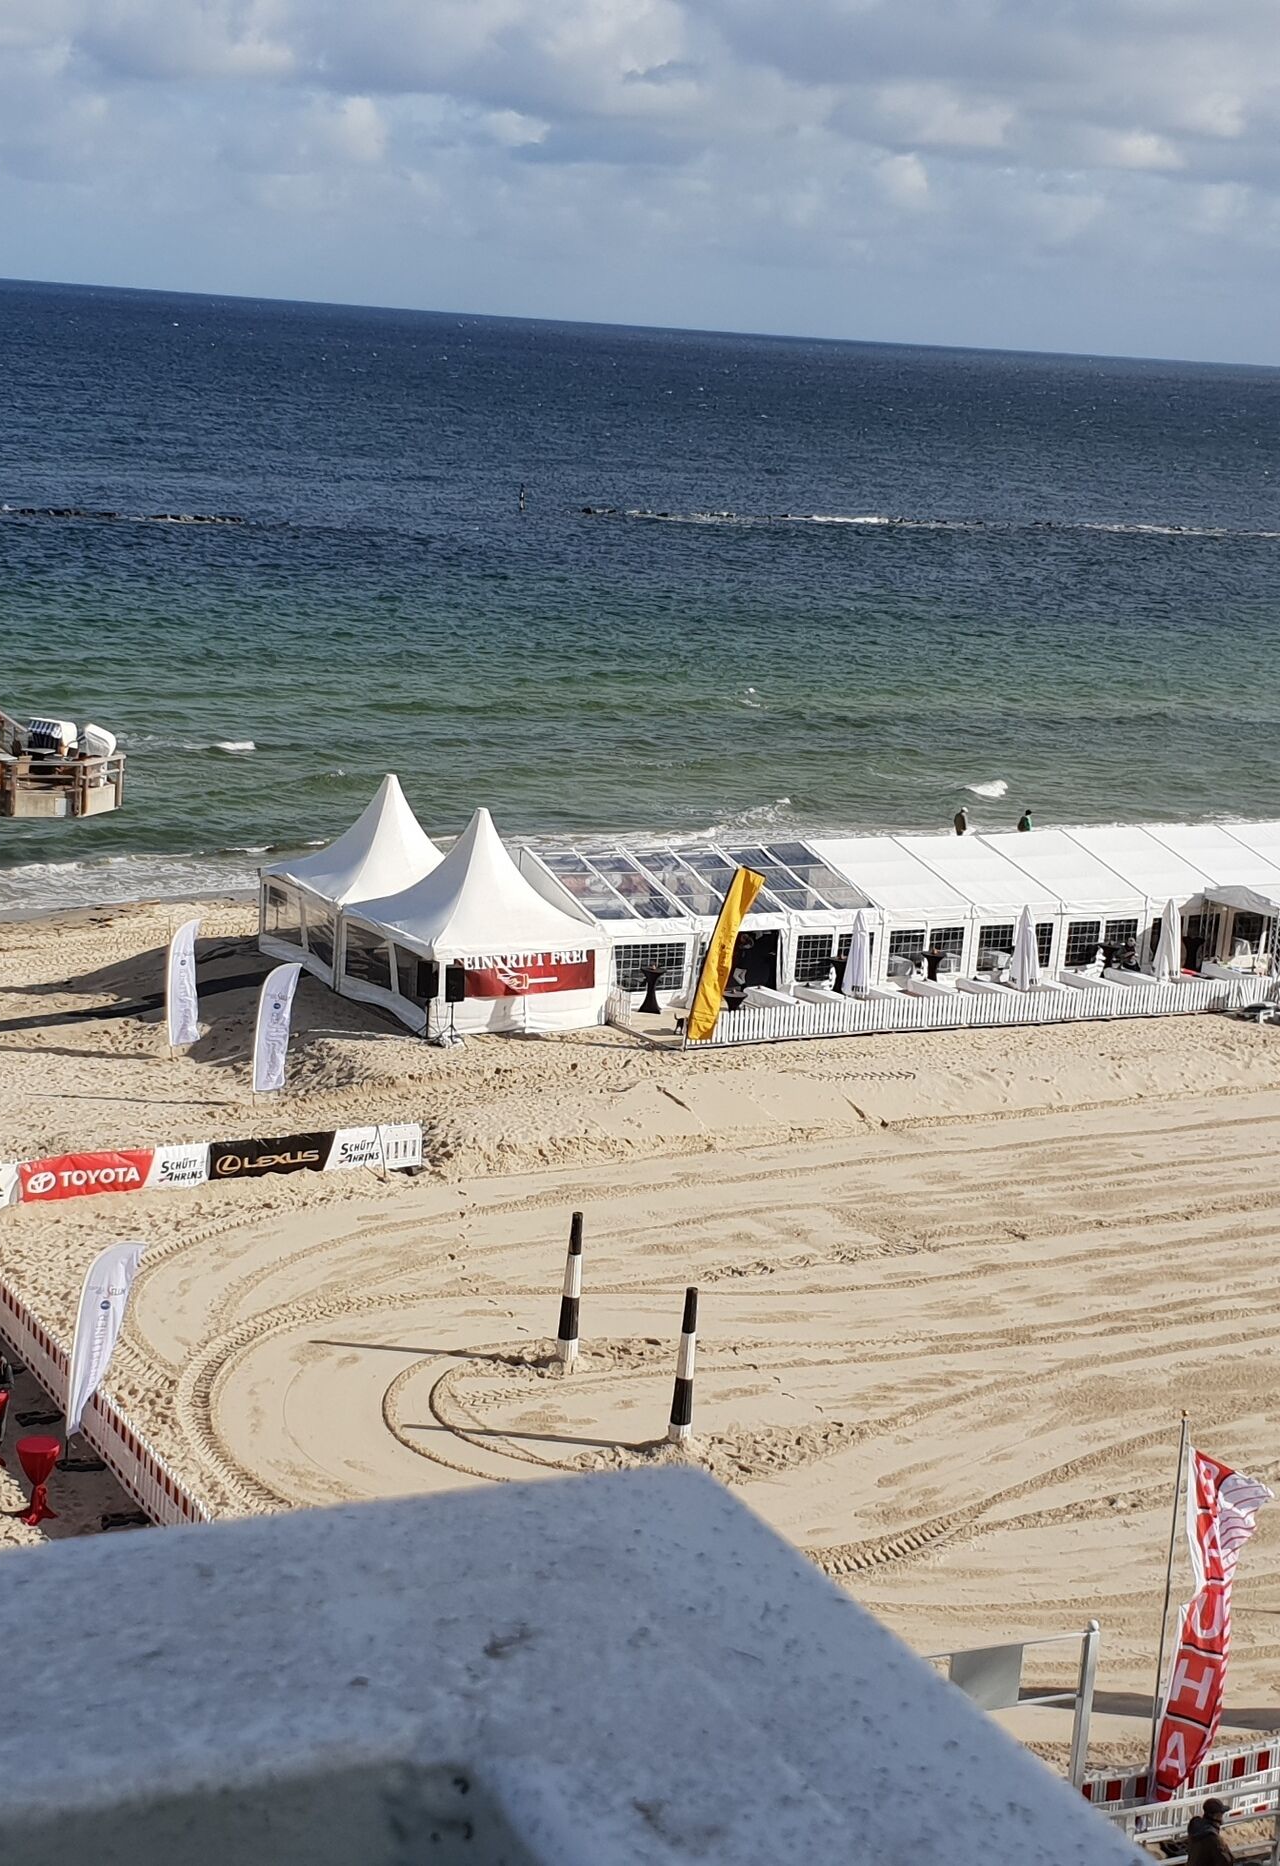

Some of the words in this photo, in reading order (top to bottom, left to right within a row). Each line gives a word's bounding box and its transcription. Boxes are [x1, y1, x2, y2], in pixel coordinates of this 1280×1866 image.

[464, 952, 546, 970] EINTRITT
[550, 949, 588, 965] FREI
[339, 1139, 376, 1155] SCHÜTT
[160, 1157, 197, 1174] SCHÜTT
[244, 1150, 320, 1169] LEXUS
[60, 1166, 141, 1188] TOYOTA
